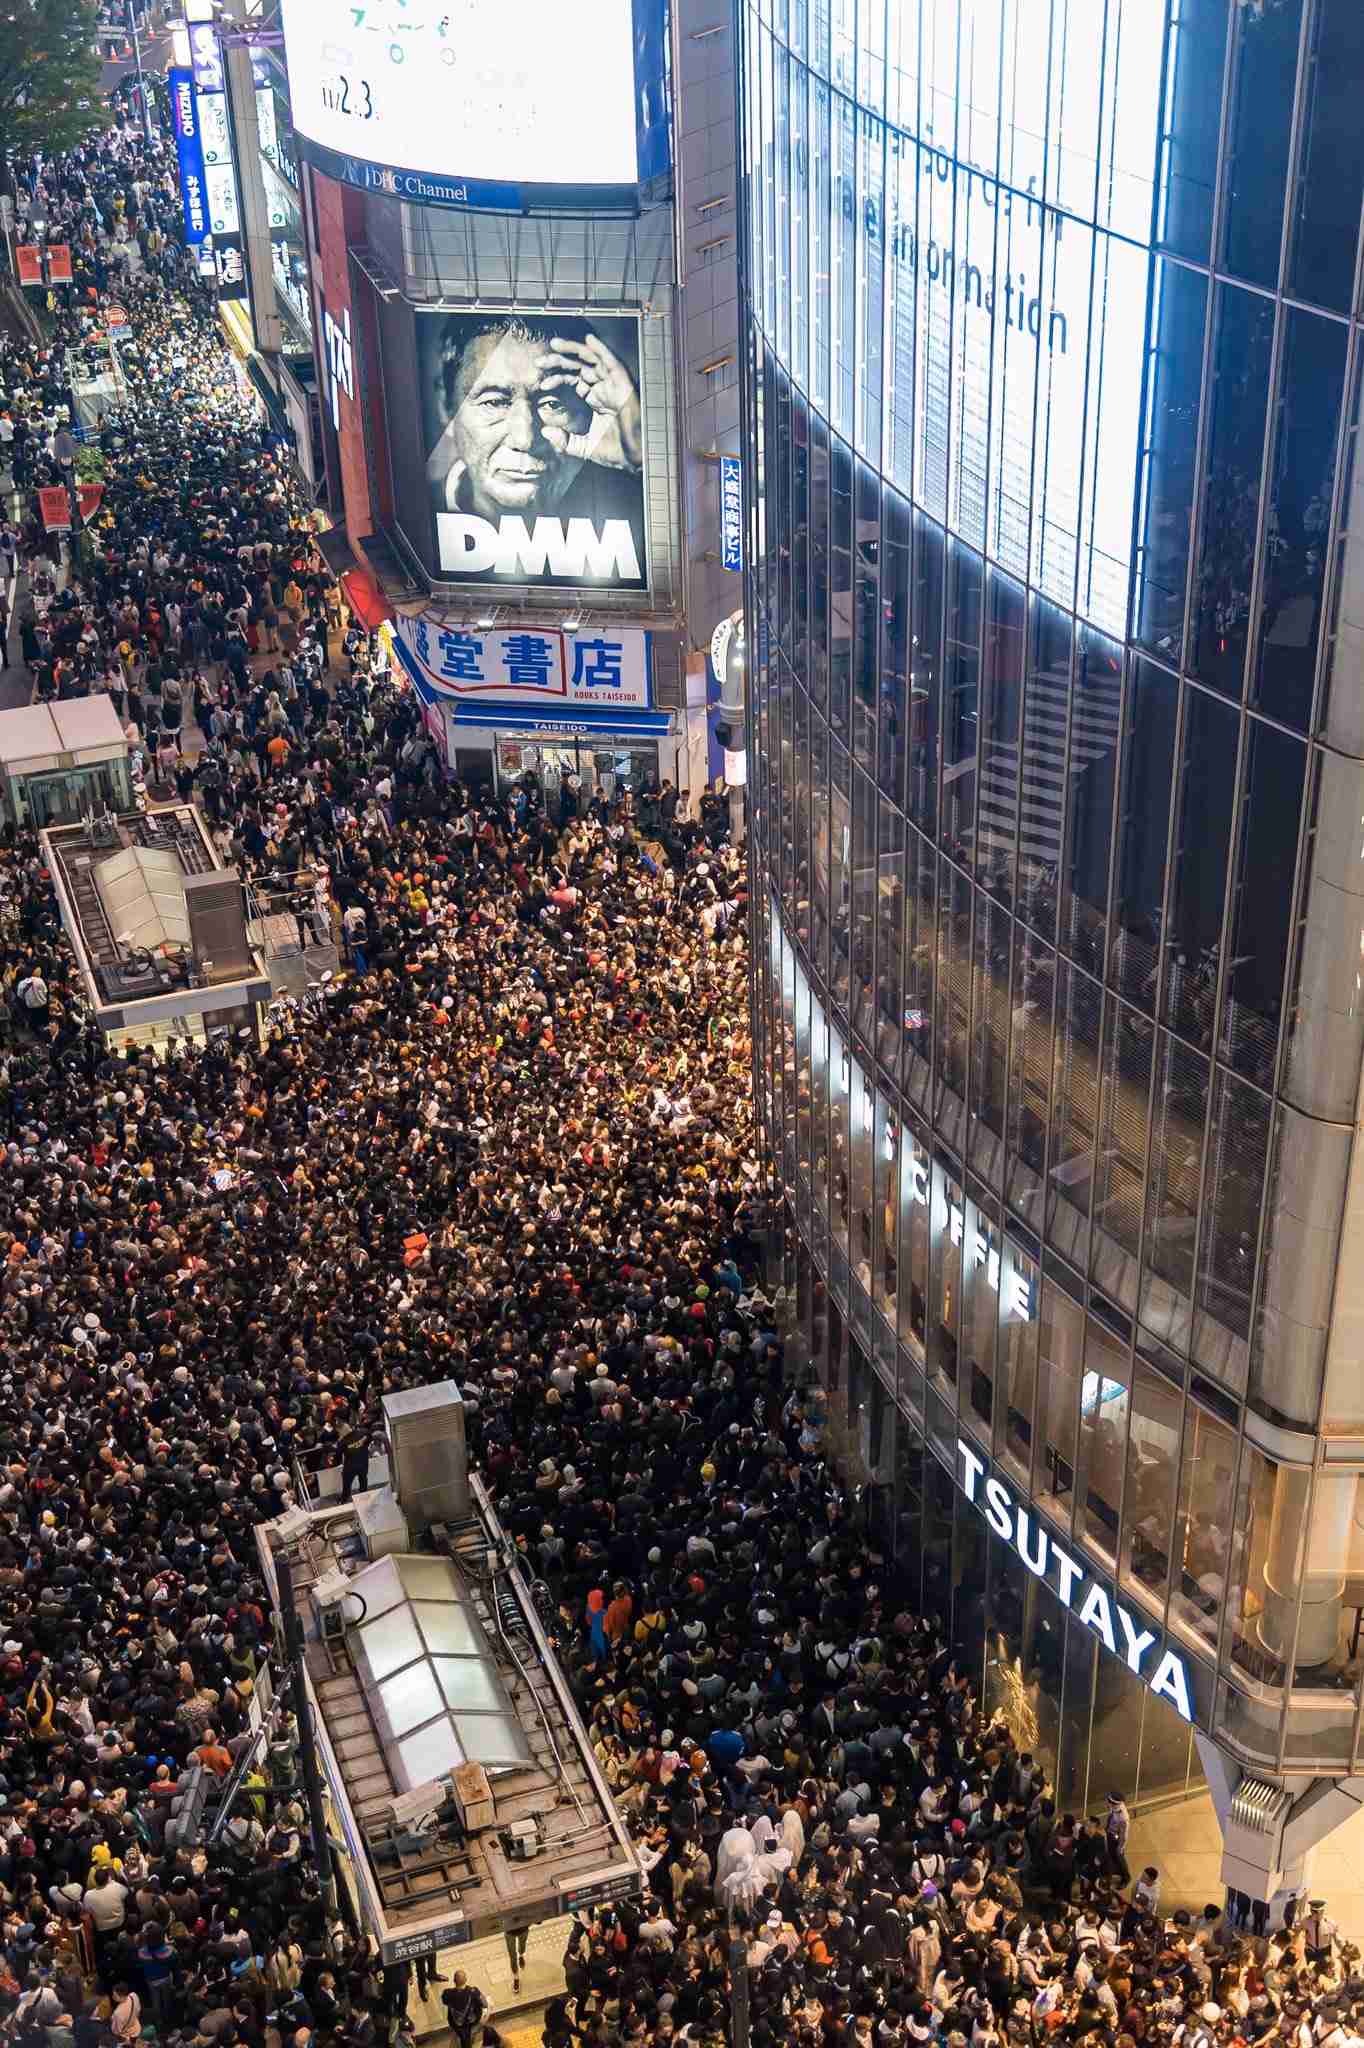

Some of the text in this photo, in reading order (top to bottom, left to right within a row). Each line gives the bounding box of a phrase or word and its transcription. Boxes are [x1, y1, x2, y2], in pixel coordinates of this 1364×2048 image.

[176, 82, 195, 137] MIZUHO
[372, 169, 468, 201] DHC Channel
[436, 512, 641, 580] DMM
[574, 690, 637, 702] BOOKS TAISEIDO
[532, 722, 588, 732] TAISEIDO
[957, 1437, 1193, 1723] TSUTAYA
